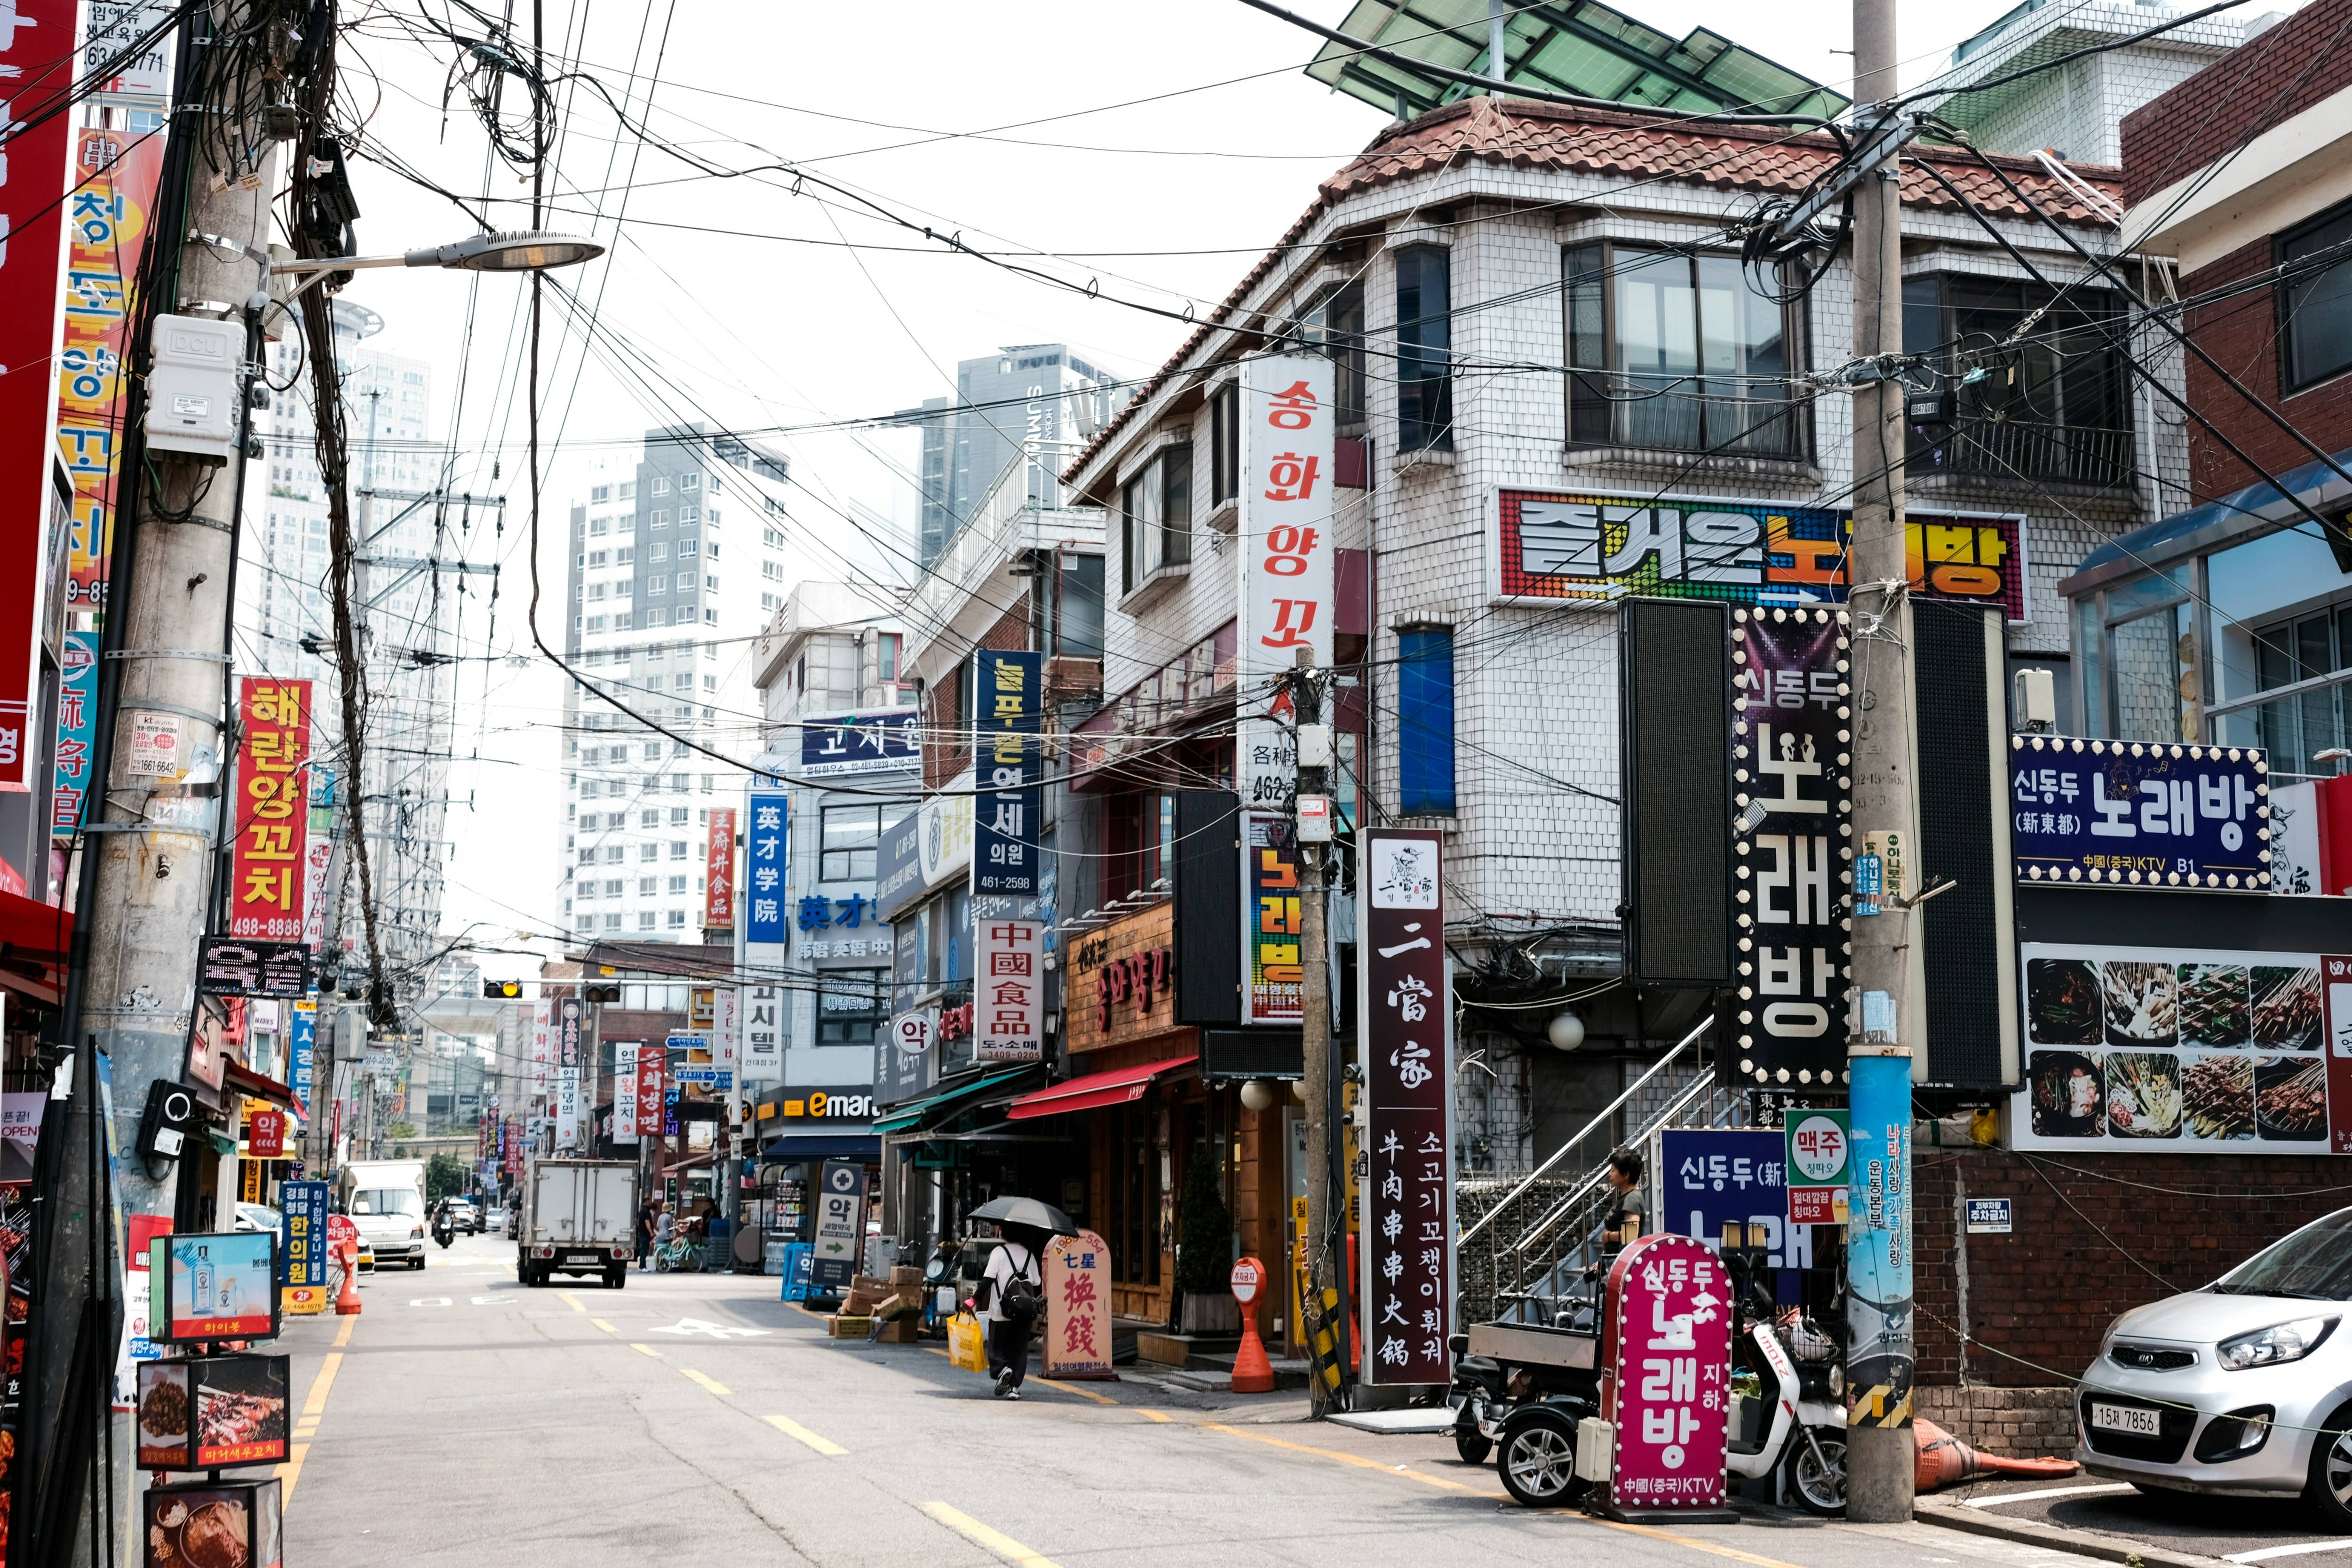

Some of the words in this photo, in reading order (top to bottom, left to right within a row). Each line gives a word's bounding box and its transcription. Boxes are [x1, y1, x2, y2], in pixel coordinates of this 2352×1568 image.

[88, 6, 140, 24] 임에듀
[175, 337, 216, 353] DCU
[1742, 669, 1840, 710] 신동두
[141, 760, 174, 773] 1661-6642
[243, 686, 301, 910] 해란양꼬치
[2014, 770, 2080, 804] 신동두
[2091, 772, 2255, 852] 노래방
[2015, 812, 2080, 836] (新東都)
[709, 812, 731, 916] 王府井食品
[755, 806, 781, 923] 英才学院
[990, 844, 1023, 865] 의원
[2177, 858, 2194, 874] B1
[981, 876, 1029, 889] 461-2598
[1754, 723, 1835, 1037] 노래방
[1869, 858, 1879, 913] 하나로신
[798, 893, 890, 931] 英才
[833, 939, 866, 957] 英语
[991, 923, 1032, 1035] 中國食品
[1378, 922, 1433, 1089] 二當家
[902, 1021, 927, 1049] 약
[258, 1116, 278, 1138] 약
[1797, 1130, 1841, 1158] 맥주
[1359, 1163, 1366, 1175] 68
[1807, 1163, 1835, 1175] 칭따오
[1887, 1124, 1899, 1194] 나라사랑
[1680, 1154, 1754, 1192] 신동두
[286, 1187, 308, 1199] 경희
[1793, 1192, 1829, 1204] 절대깔끔
[829, 1199, 851, 1222] 약
[1794, 1206, 1821, 1218] 칭따오
[1971, 1210, 2008, 1222] 주차금지
[1976, 1201, 2001, 1210] 외부차량
[328, 1226, 355, 1238] 차금지
[1888, 1197, 1901, 1267] 가족사랑
[289, 1216, 309, 1284] 한의원
[1377, 1129, 1410, 1367] 牛肉串串火锅
[1417, 1131, 1444, 1366] 소고기꼬챙이훠궈
[1063, 1253, 1096, 1269] 七星
[1234, 1271, 1255, 1281] 주차금지
[297, 1292, 309, 1301] 2F
[2138, 1354, 2153, 1363] KIA
[1703, 1362, 1721, 1411] 지하
[2099, 1407, 2120, 1425] 15저
[2124, 1409, 2155, 1431] 7856
[206, 1444, 276, 1462] 마라새우꼬치
